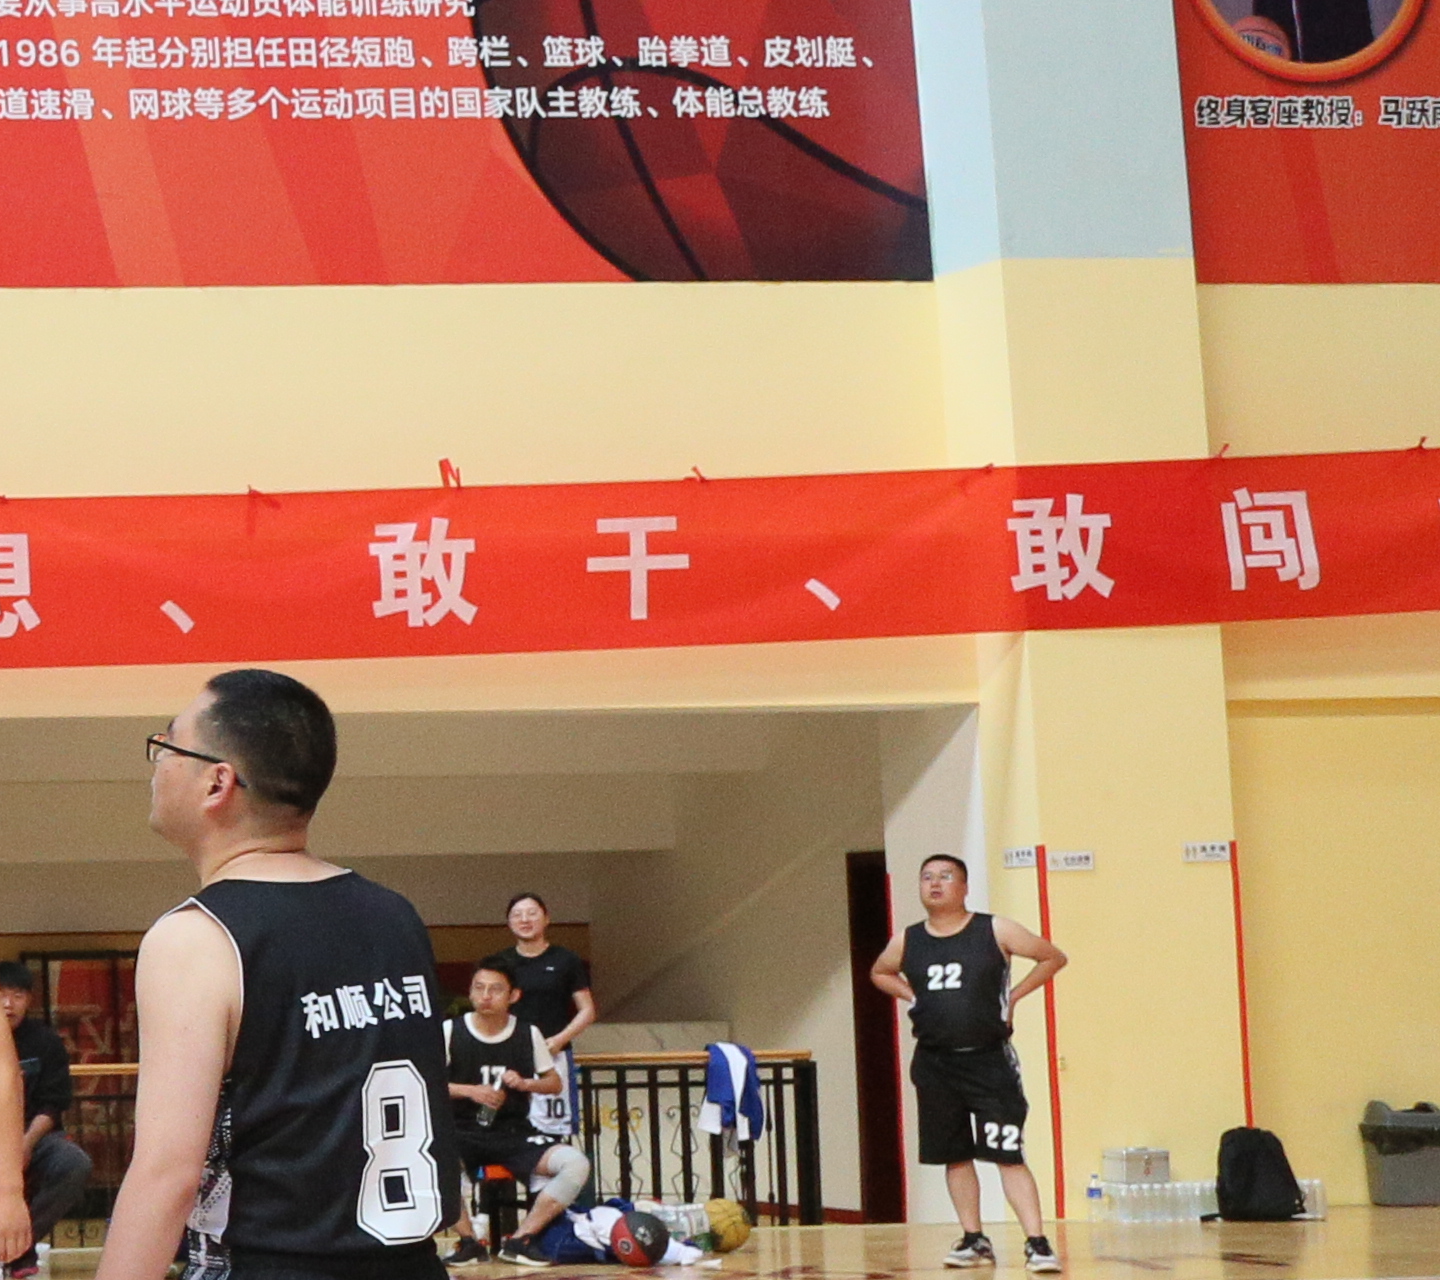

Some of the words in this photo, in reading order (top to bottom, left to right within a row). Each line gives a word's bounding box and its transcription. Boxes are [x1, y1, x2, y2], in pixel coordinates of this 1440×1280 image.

[926, 963, 963, 991] 22
[301, 975, 432, 1039] 和顺公司
[480, 1065, 506, 1091] 17
[546, 1097, 565, 1119] 10
[984, 1122, 1020, 1151] 22
[357, 1059, 442, 1246] 8
